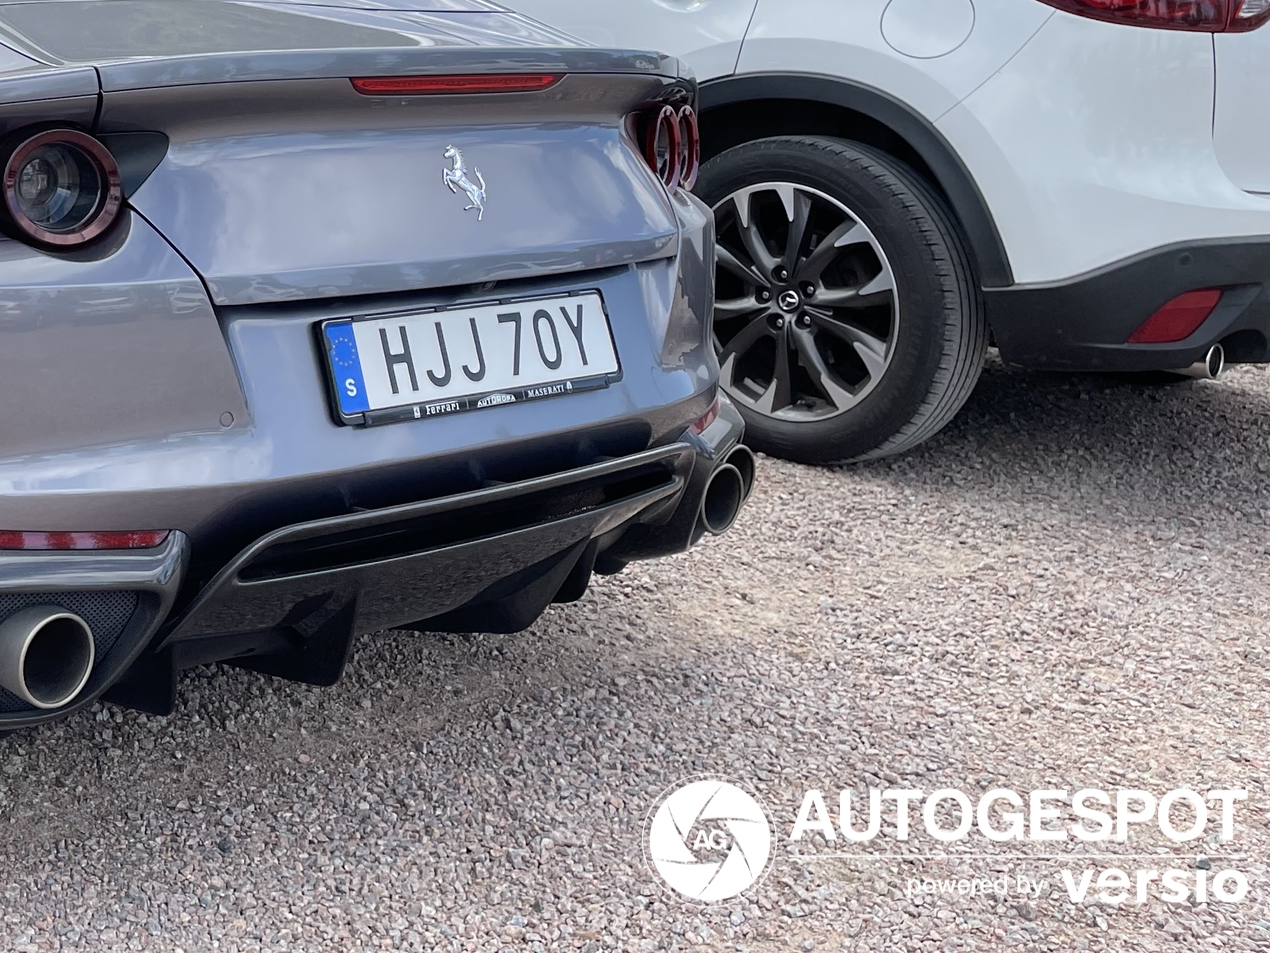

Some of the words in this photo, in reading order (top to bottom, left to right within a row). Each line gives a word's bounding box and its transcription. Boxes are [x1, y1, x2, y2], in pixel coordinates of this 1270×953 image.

[346, 378, 357, 397] S
[425, 400, 460, 416] Ferrari
[527, 384, 565, 398] MASERATI
